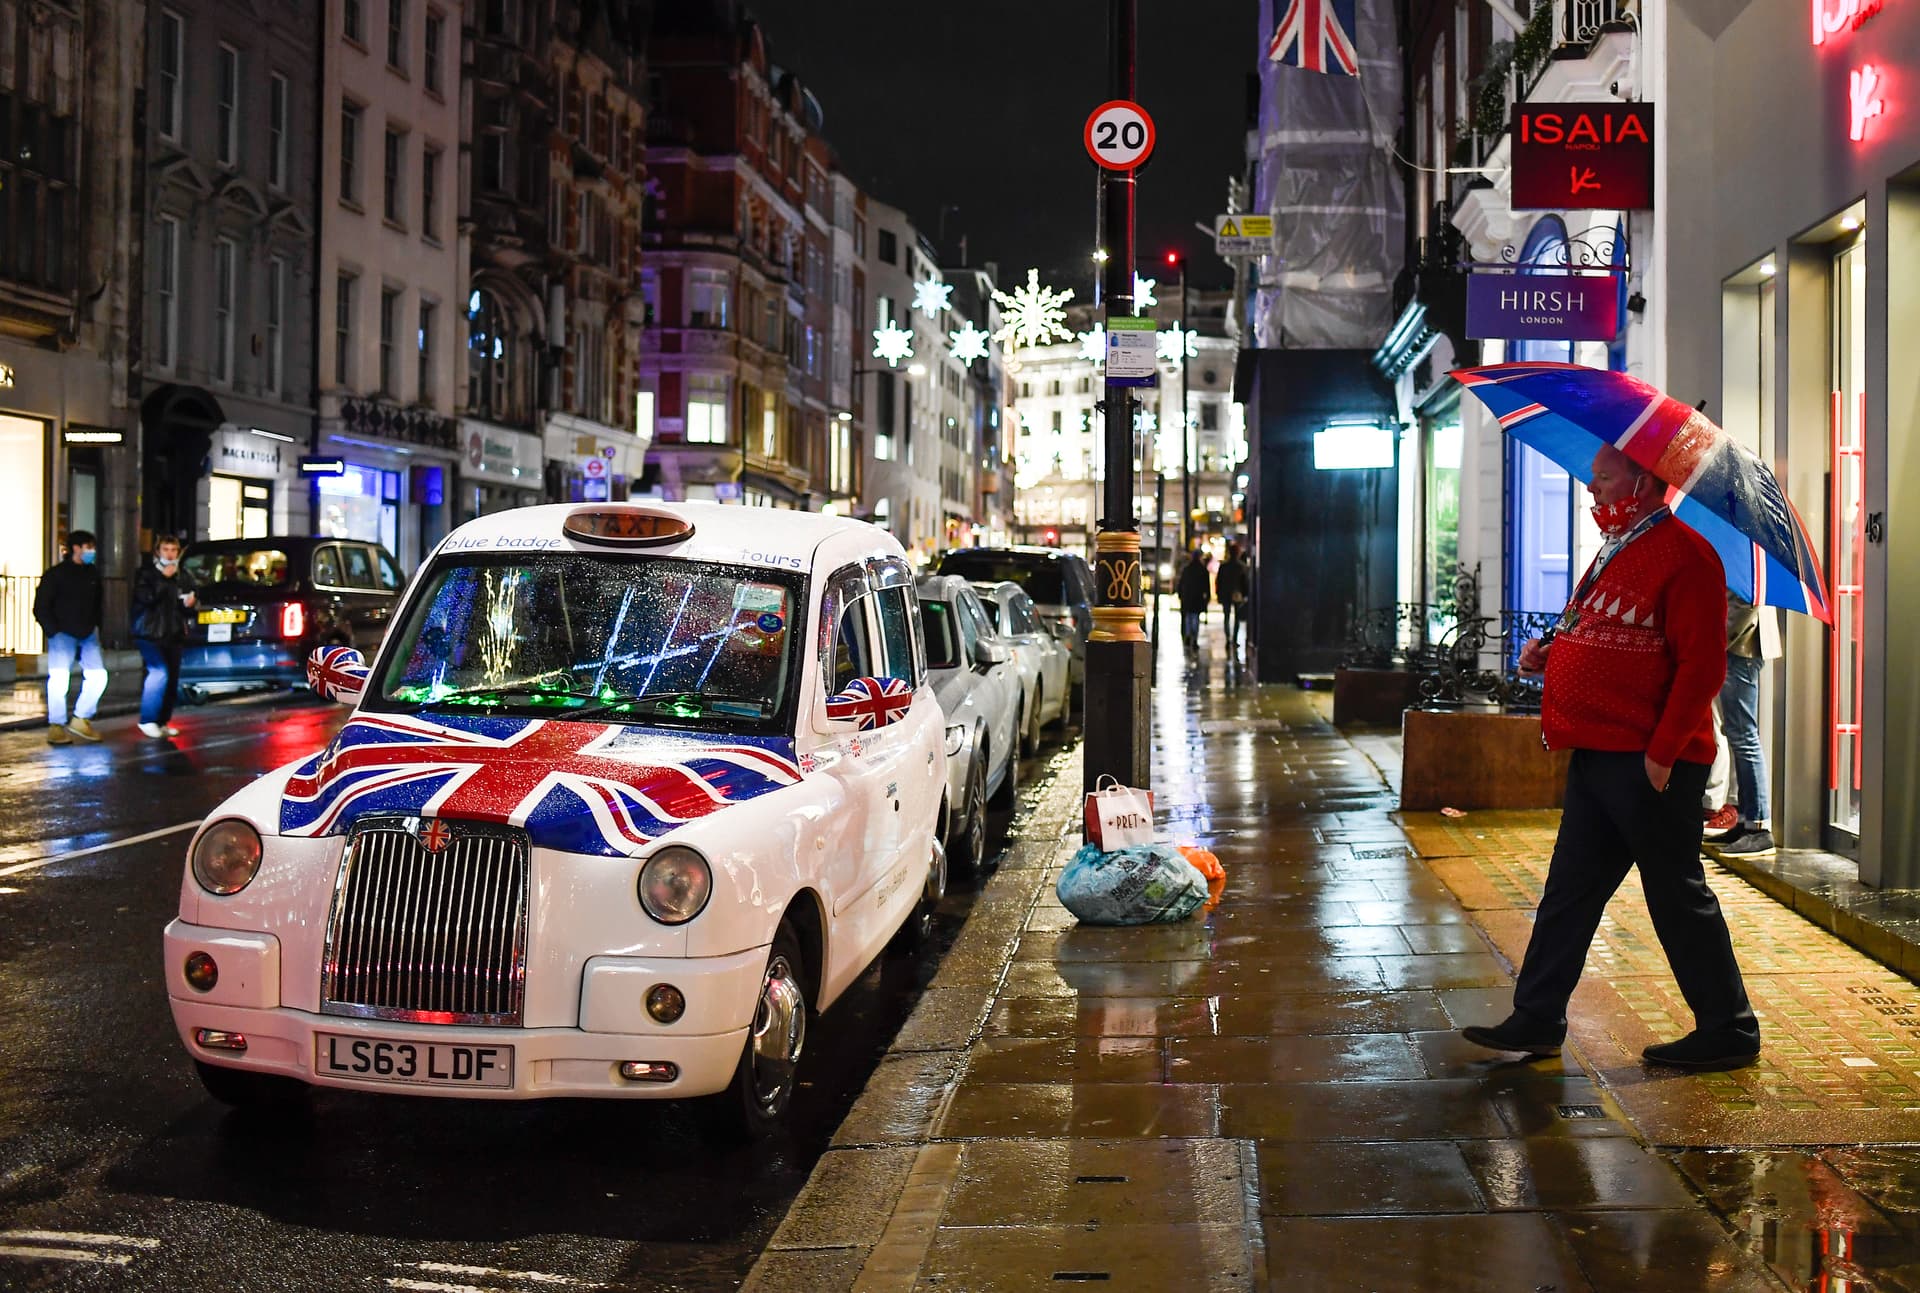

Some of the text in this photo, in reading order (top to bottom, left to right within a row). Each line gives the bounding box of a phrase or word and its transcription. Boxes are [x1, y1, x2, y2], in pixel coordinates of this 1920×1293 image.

[1096, 121, 1145, 149] 20
[1521, 113, 1649, 144] ISAIA
[1501, 290, 1584, 312] HIRSH
[1520, 316, 1563, 324] LONDON
[589, 513, 661, 537] TAXI
[445, 535, 801, 568] blue badge tours
[1116, 813, 1138, 830] PRET
[329, 1038, 498, 1081] LS63 LDF
